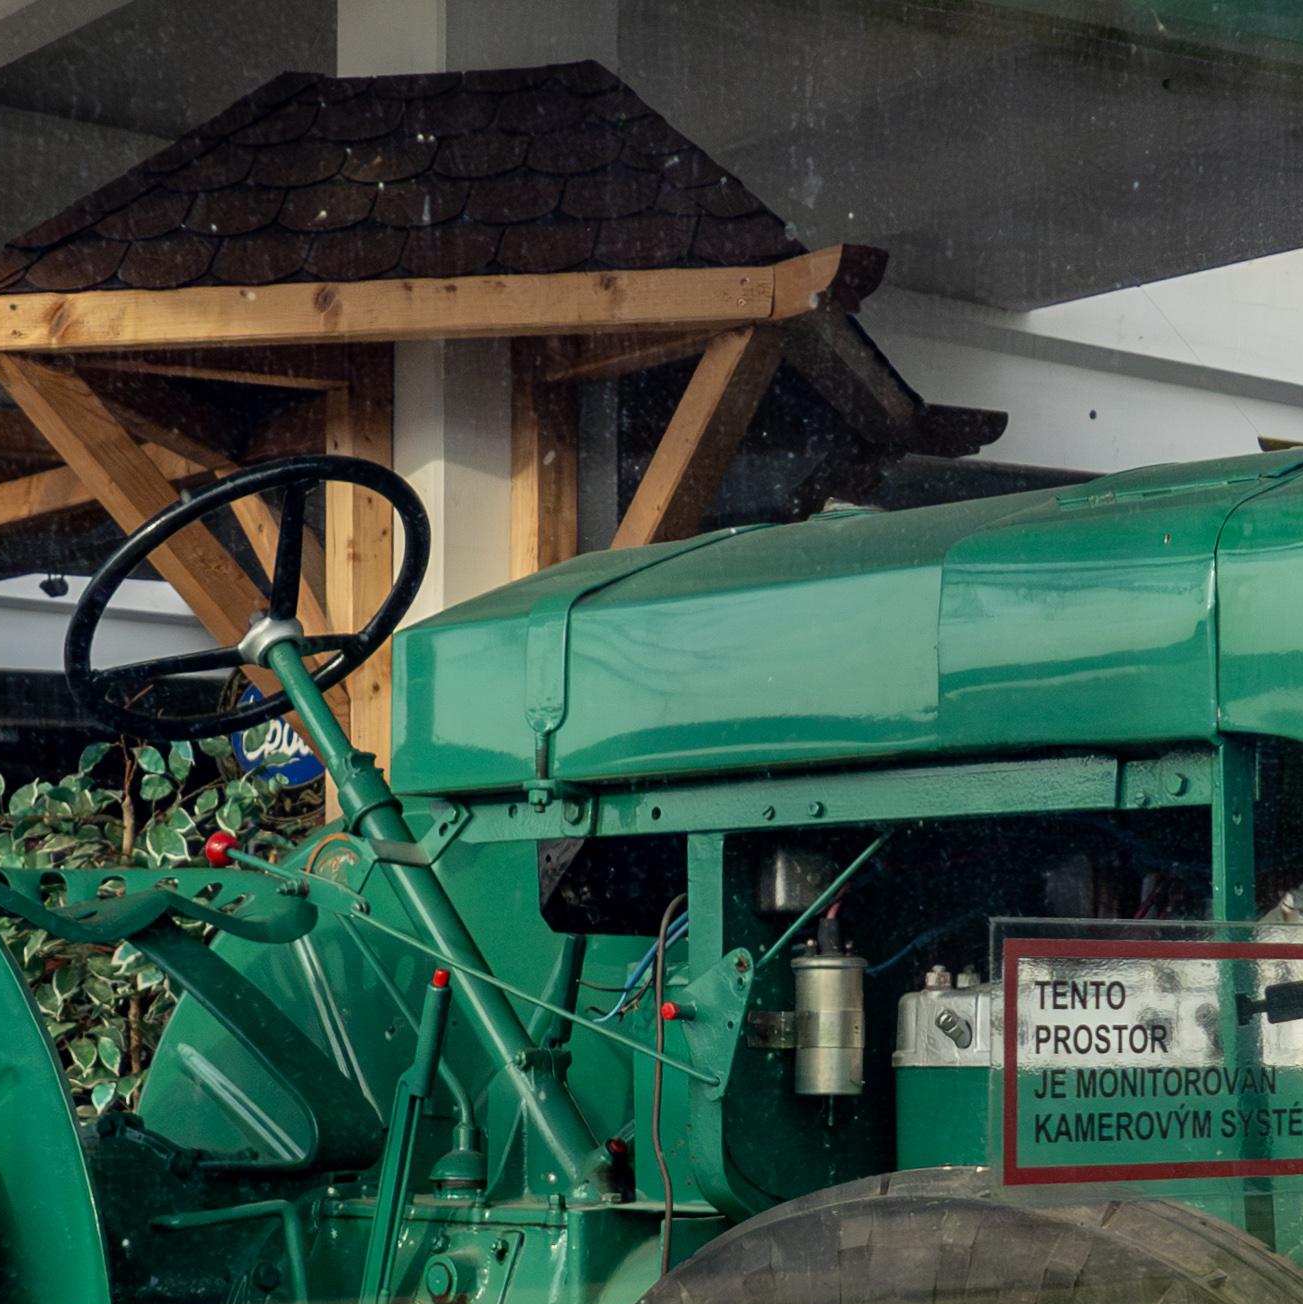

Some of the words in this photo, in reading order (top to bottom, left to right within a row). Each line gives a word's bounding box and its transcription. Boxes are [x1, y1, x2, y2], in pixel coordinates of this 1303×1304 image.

[1035, 980, 1126, 1010] TENTO
[1035, 1024, 1169, 1054] PROSTOR
[1034, 1069, 1066, 1099] JE
[1035, 1104, 1212, 1143] KAMEROVÝM
